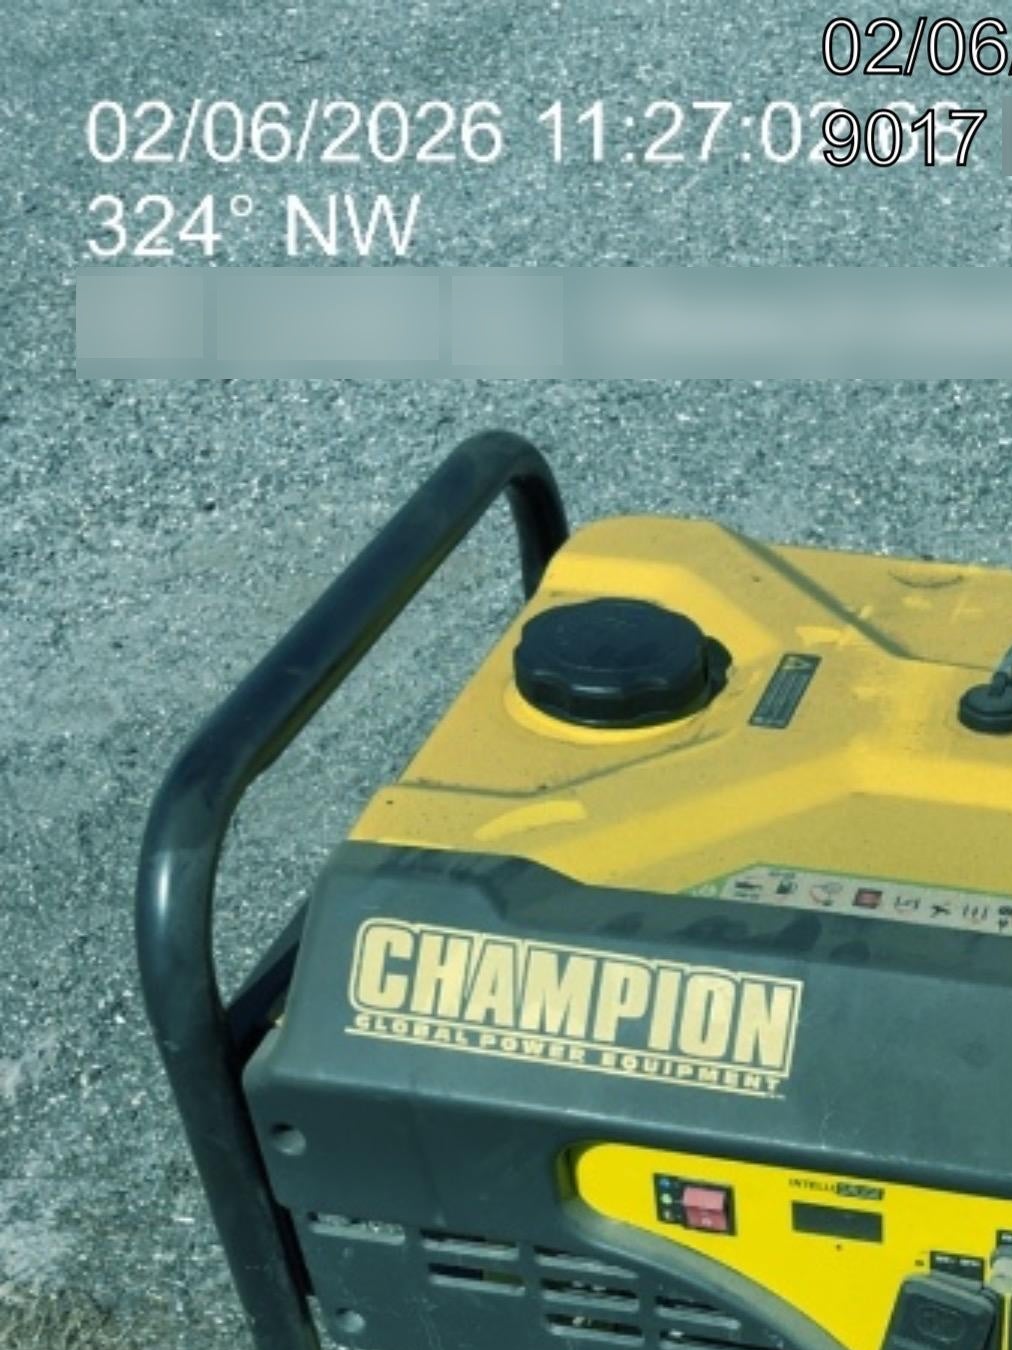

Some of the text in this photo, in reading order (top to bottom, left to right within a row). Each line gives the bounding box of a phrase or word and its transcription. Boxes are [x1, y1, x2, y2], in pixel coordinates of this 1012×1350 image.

[355, 922, 796, 1069] CHAMPION
[353, 1013, 783, 1092] GLOBAL POWER EQUIPMENT
